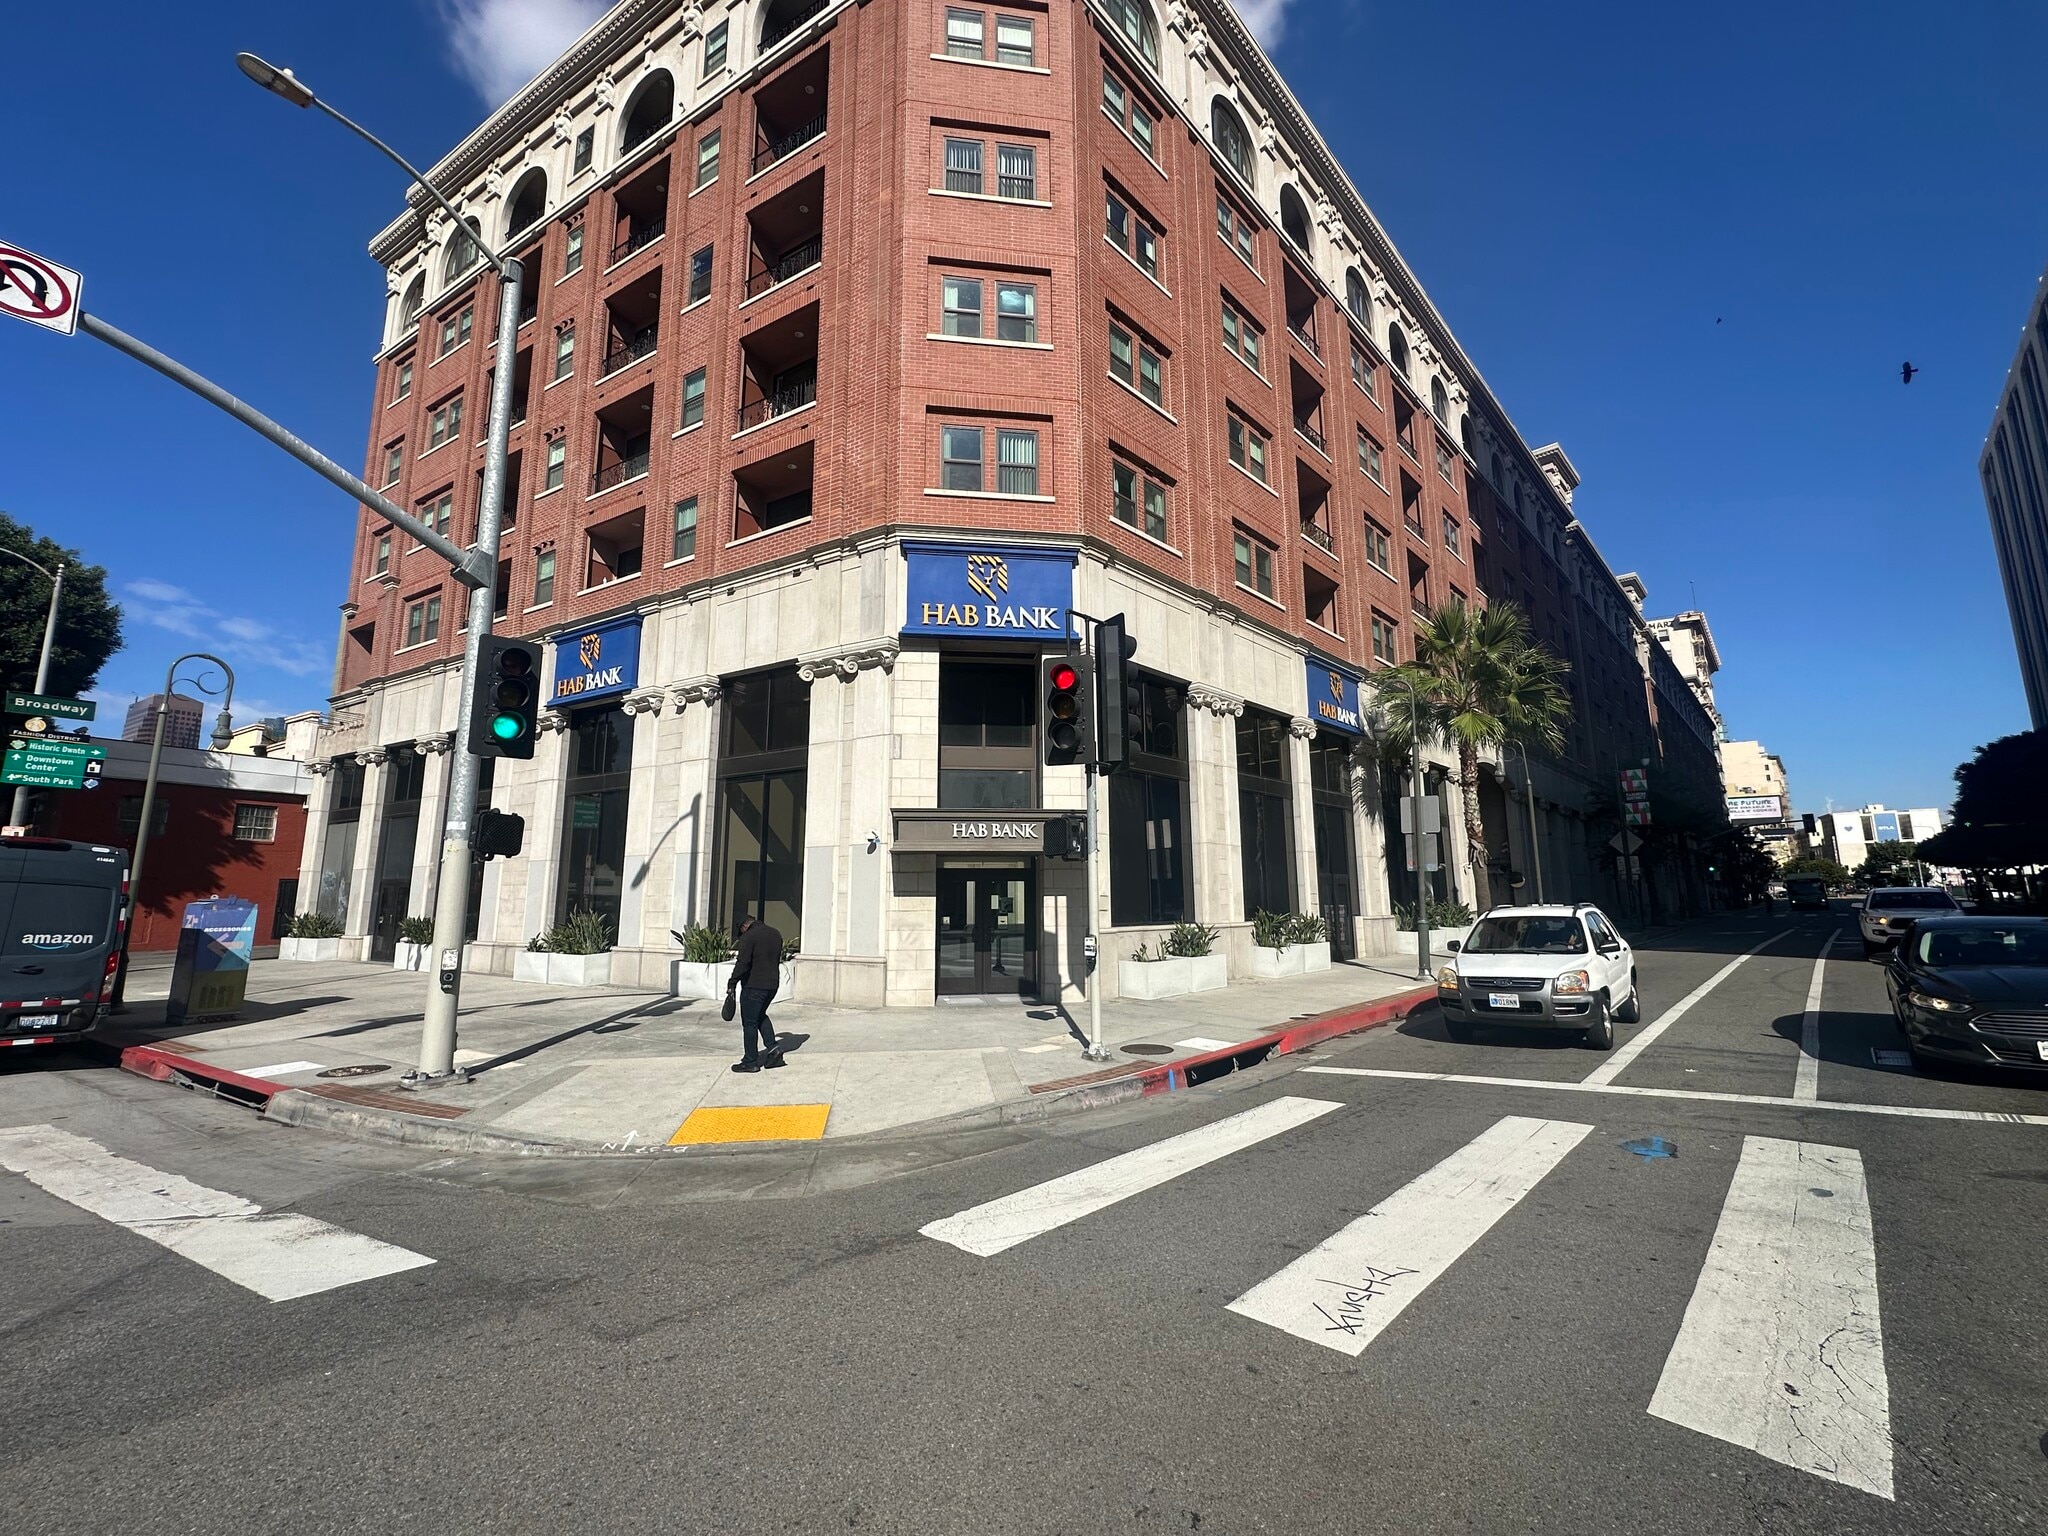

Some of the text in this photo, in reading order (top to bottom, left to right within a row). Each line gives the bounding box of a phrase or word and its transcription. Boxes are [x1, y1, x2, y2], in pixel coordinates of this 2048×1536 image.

[922, 603, 1061, 630] HAB BANK
[557, 665, 623, 697] HAB BANK
[15, 698, 88, 716] Broadway
[1318, 700, 1359, 728] HAB BANK
[29, 743, 86, 755] Historic Dwntn
[25, 762, 58, 772] Center
[26, 754, 74, 766] Downtown
[22, 774, 74, 786] South Park
[952, 823, 1039, 839] HAB BANK
[22, 934, 93, 944] amazon
